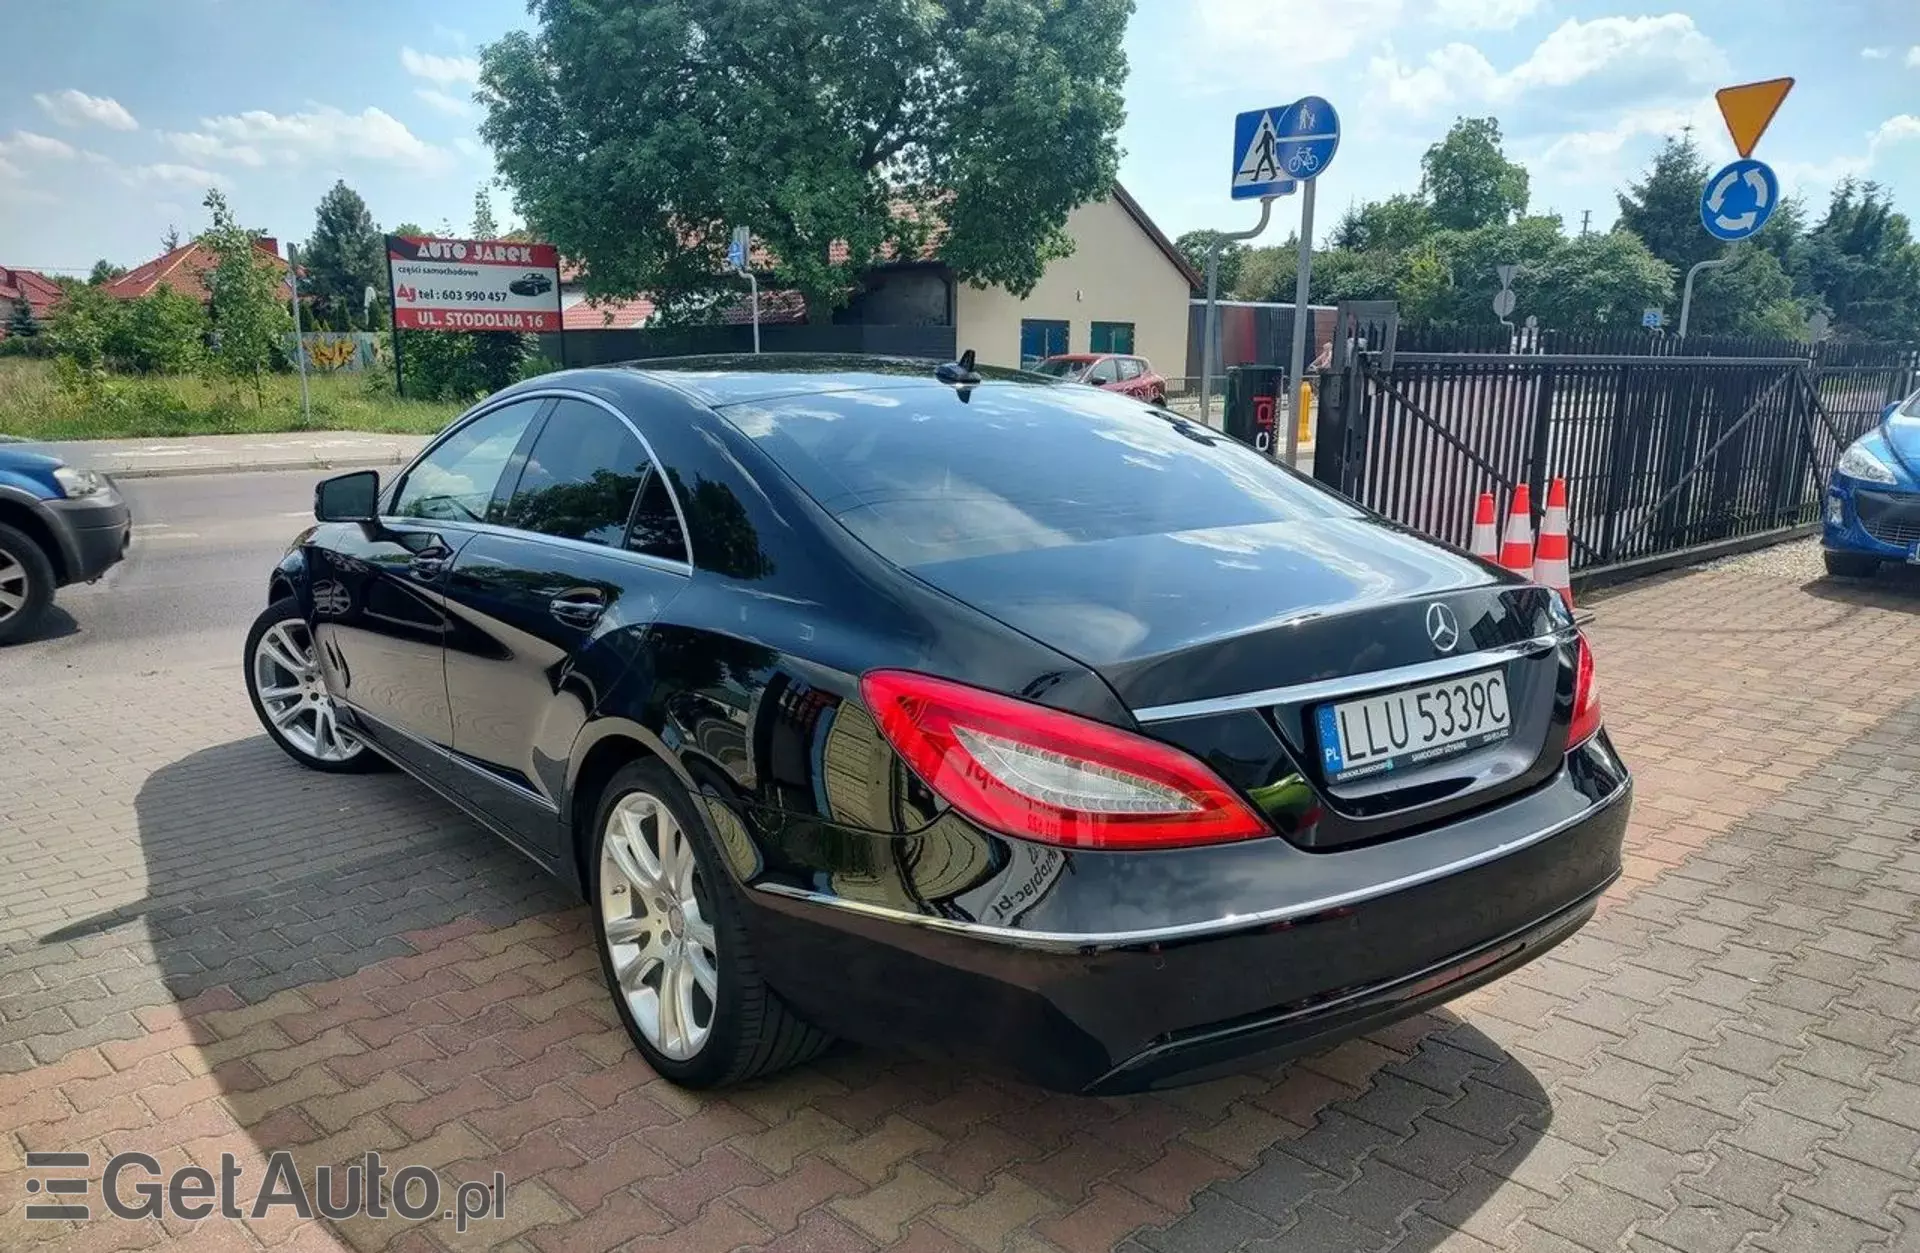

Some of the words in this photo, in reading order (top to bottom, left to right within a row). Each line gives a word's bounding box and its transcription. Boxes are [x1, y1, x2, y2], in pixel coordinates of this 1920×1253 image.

[417, 242, 467, 258] AUTO
[423, 266, 479, 277] samochodowe
[442, 290, 462, 301] 603
[465, 291, 486, 302] 990
[488, 292, 508, 302] 457
[417, 312, 442, 326] UL.
[447, 312, 523, 327] STODOLNA
[527, 315, 543, 327] 16
[1340, 697, 1410, 762] LLU
[1416, 677, 1506, 742] 5339C
[1325, 746, 1341, 763] PL
